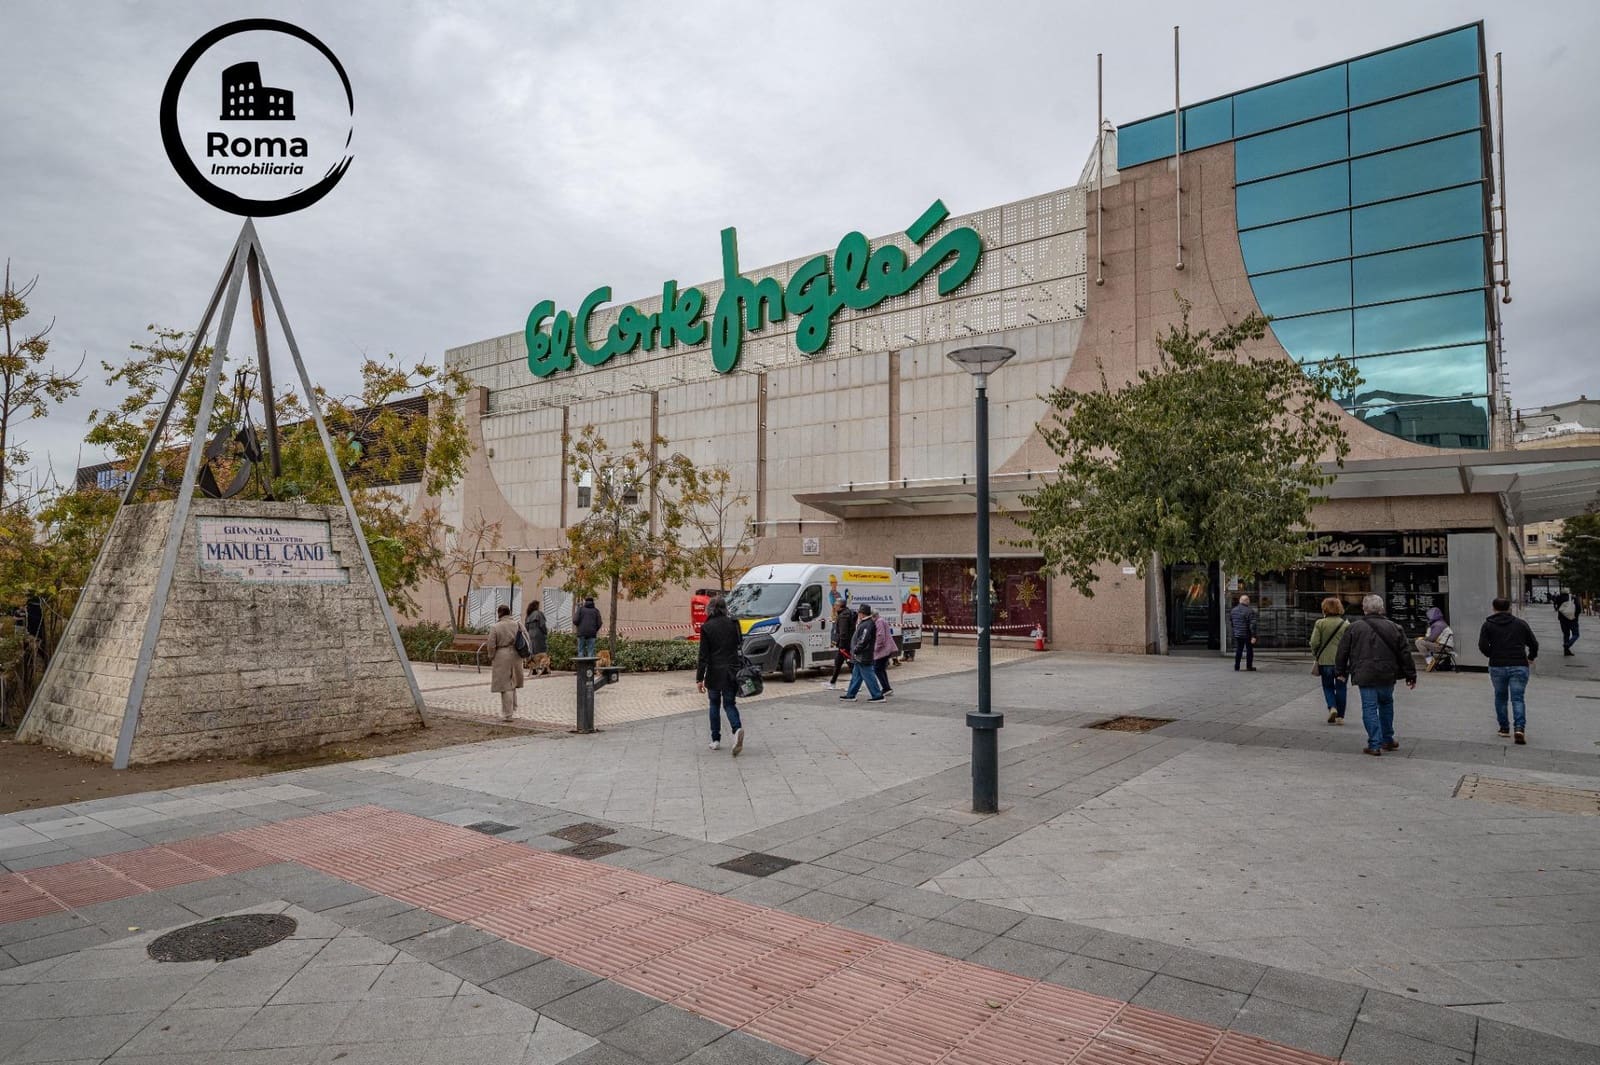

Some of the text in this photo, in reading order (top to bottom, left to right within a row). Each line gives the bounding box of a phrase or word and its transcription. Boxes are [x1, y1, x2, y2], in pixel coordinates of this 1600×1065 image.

[525, 198, 984, 377] El Corte Inglés
[224, 526, 281, 536] GRANADA
[207, 543, 324, 561] MANUEL CANO
